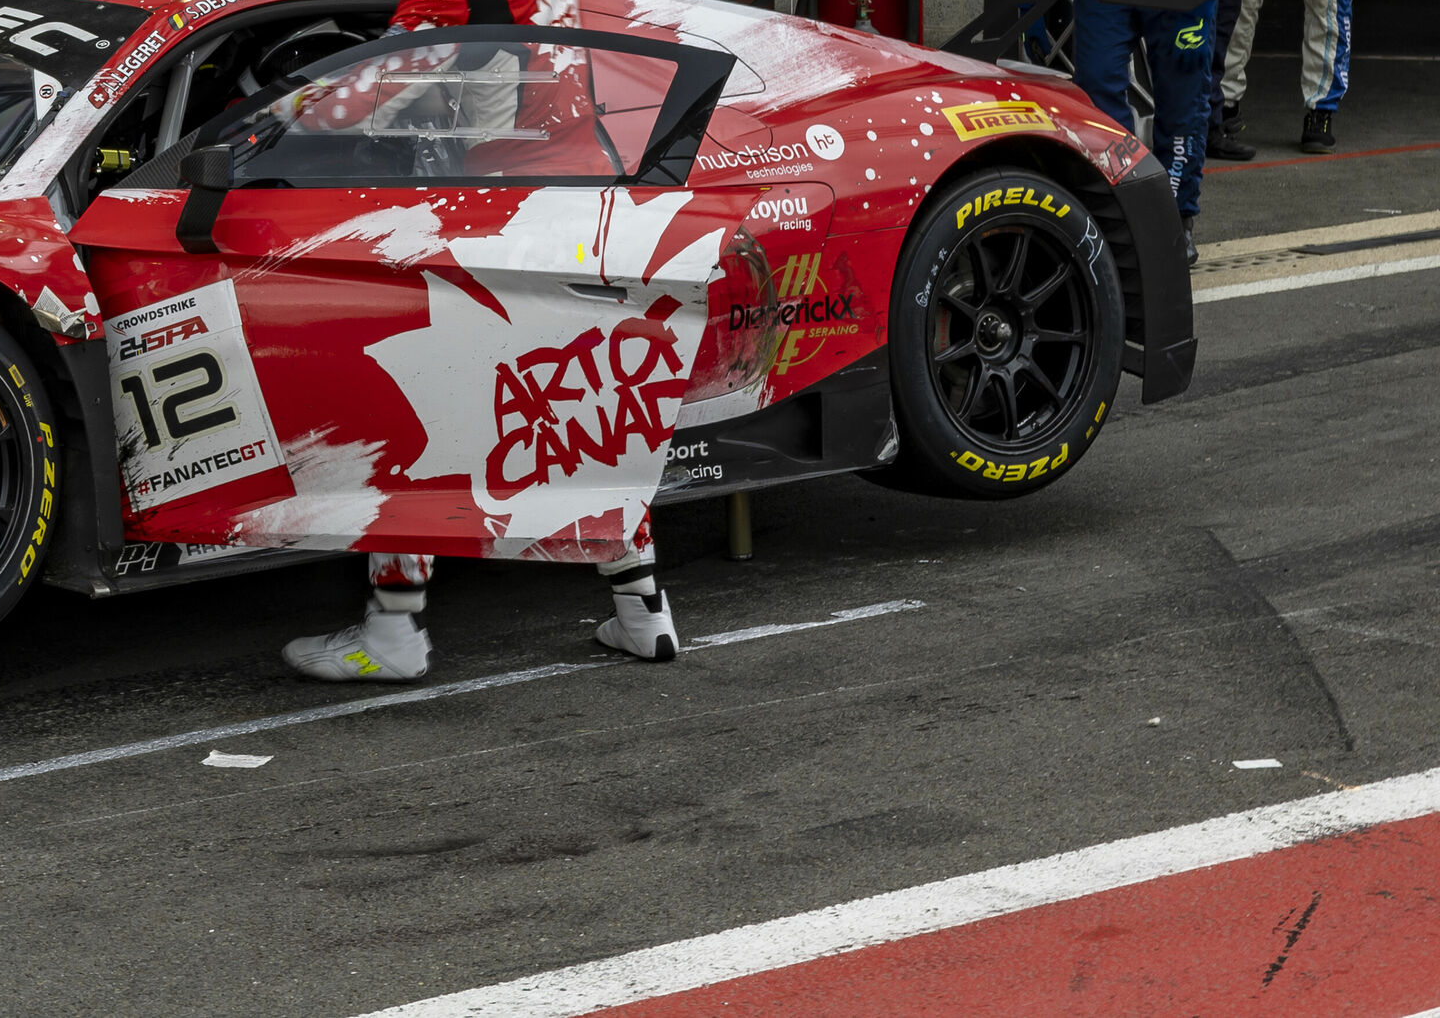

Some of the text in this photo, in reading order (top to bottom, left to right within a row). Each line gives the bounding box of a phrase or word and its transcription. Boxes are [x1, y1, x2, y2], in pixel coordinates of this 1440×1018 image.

[107, 31, 167, 92] L.LEGERET
[956, 108, 1045, 132] PIRELLI
[696, 141, 809, 170] hutchison
[1113, 134, 1141, 172] R8
[746, 161, 814, 180] technologies
[745, 197, 809, 224] toyou
[779, 216, 811, 231] racing
[956, 187, 1071, 230] PIRELLI
[117, 297, 197, 330] CROWDSTRIKE
[808, 324, 859, 338] SERAING
[494, 326, 606, 442] ART
[120, 352, 237, 448] 12
[137, 440, 266, 495] #FANATECGT
[686, 464, 723, 480] cing
